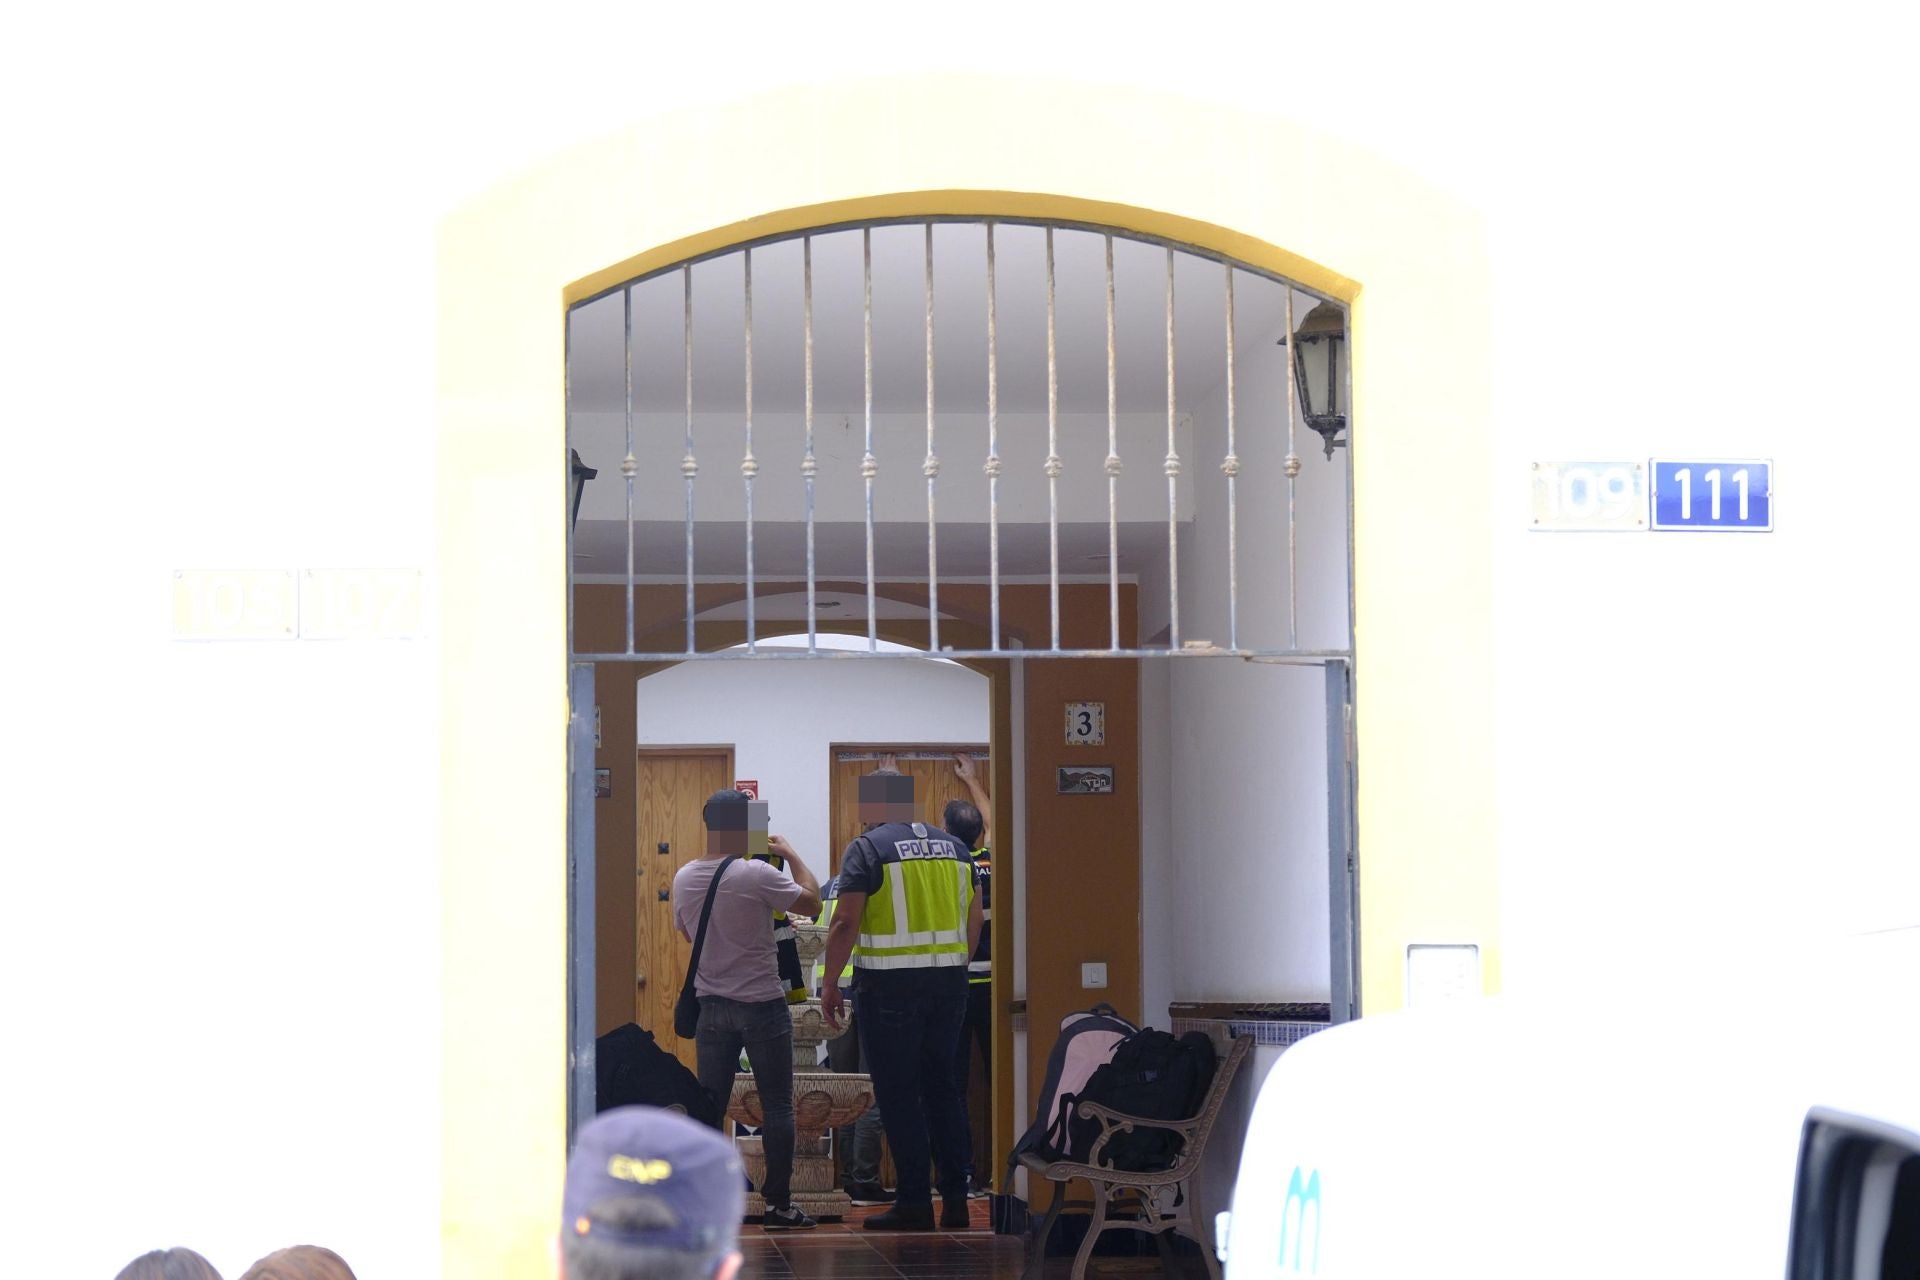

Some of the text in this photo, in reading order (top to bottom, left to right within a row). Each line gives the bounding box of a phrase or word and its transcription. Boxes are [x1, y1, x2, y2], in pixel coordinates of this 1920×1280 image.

[1535, 468, 1632, 520] 109
[1674, 468, 1749, 520] 111
[1077, 711, 1092, 736] 3
[898, 842, 956, 857] POLICIA
